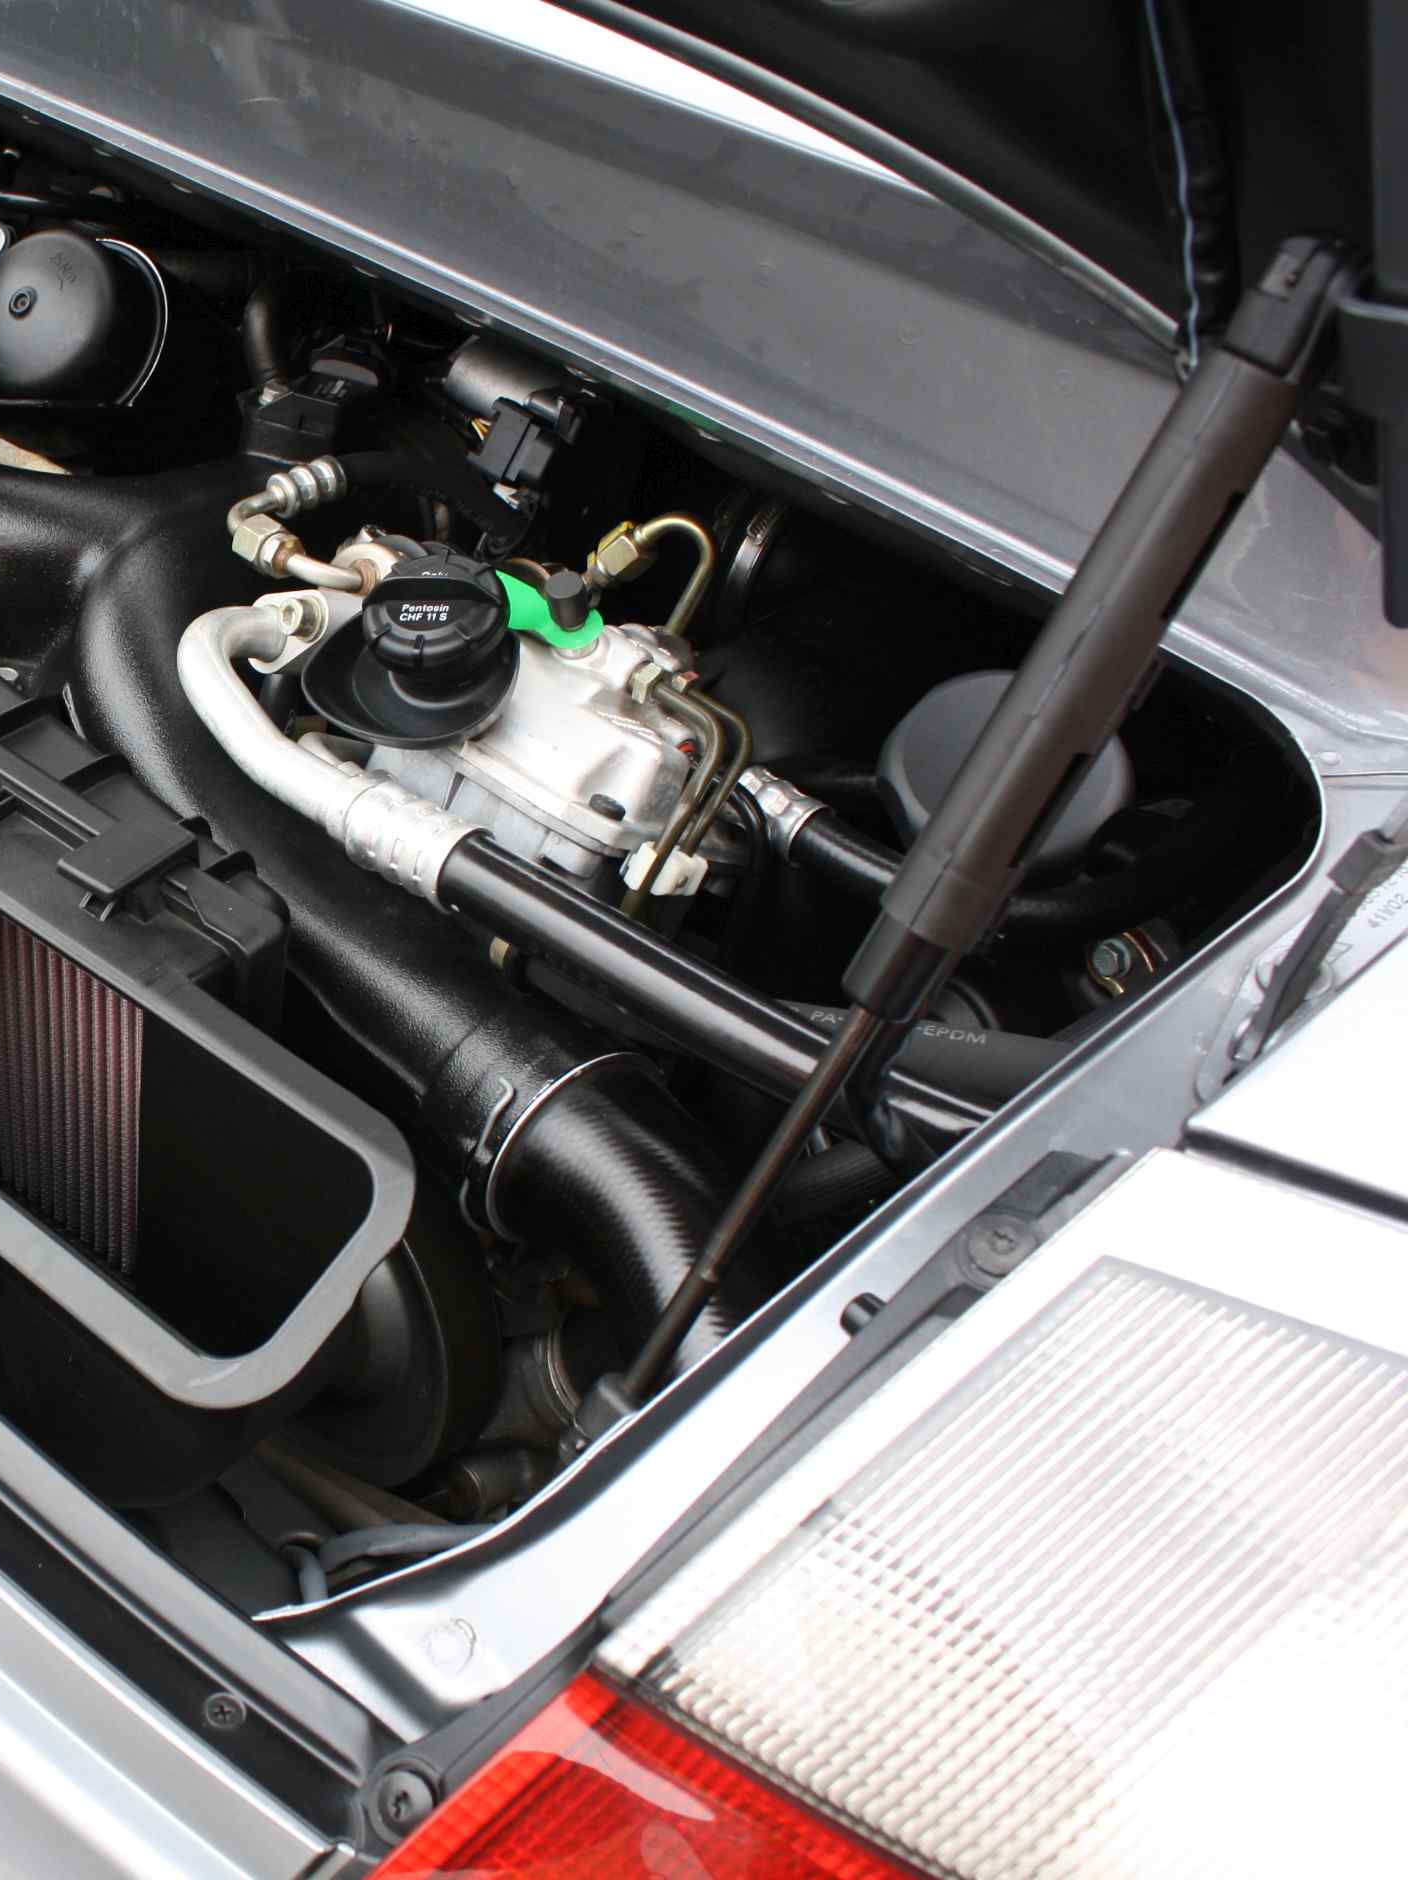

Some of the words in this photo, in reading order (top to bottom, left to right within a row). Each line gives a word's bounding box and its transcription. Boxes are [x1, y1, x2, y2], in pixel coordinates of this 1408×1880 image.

[401, 603, 450, 613] Pentosin
[399, 612, 424, 622] CHF
[426, 612, 438, 622] 11
[439, 612, 449, 622] S
